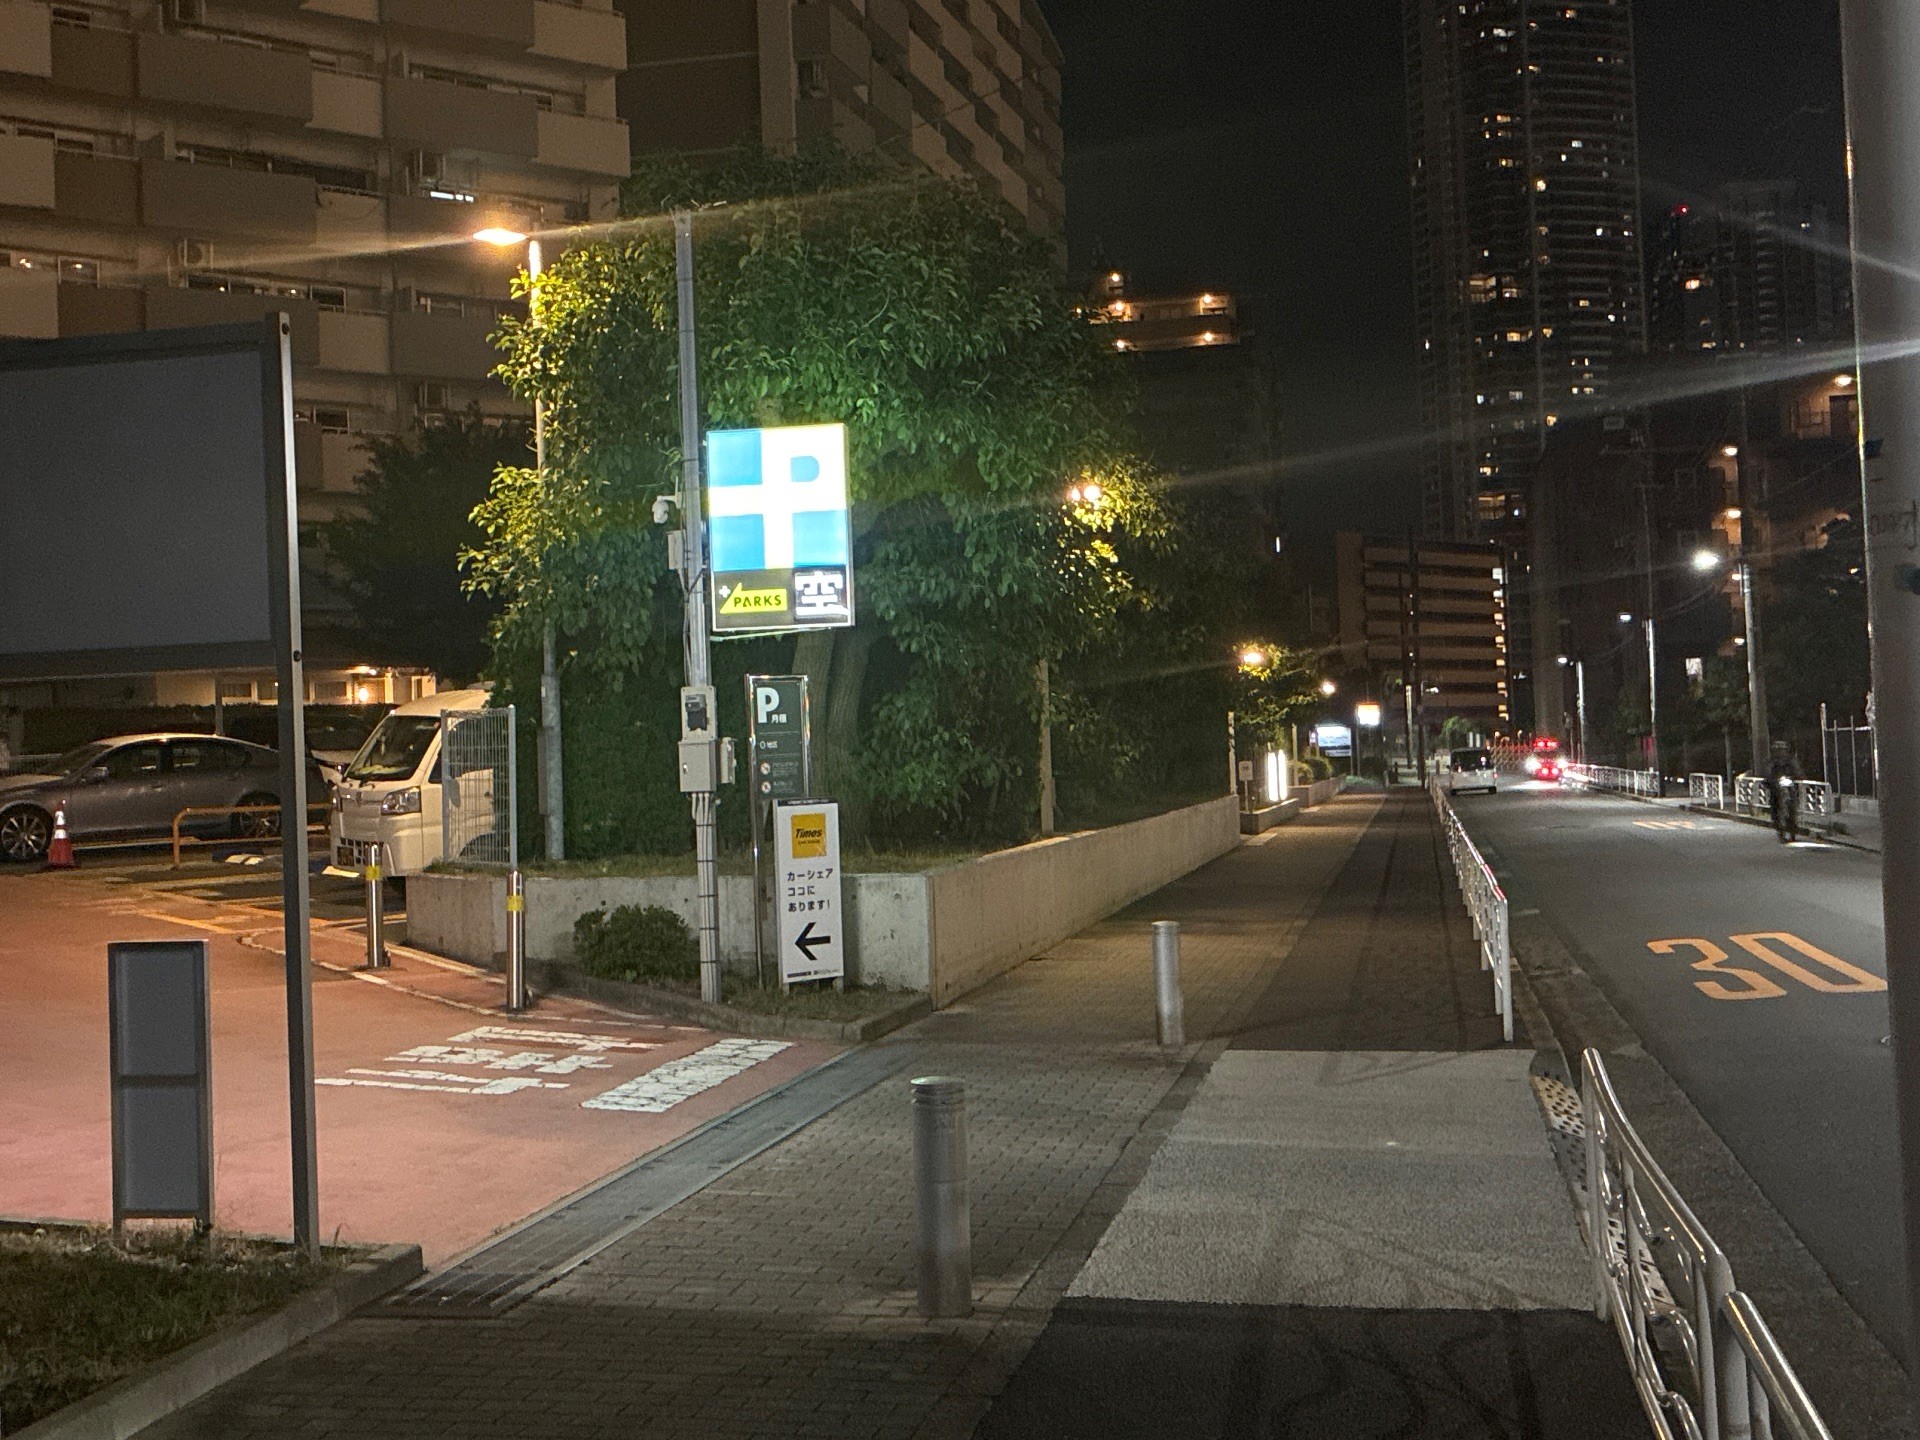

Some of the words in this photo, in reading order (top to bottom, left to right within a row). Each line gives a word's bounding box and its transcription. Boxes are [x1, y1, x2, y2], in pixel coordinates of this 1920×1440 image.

[794, 571, 849, 616] 空
[733, 594, 782, 608] PARKS
[756, 687, 780, 723] P
[795, 828, 823, 839] Times
[787, 868, 834, 882] カーシェア
[787, 885, 816, 897] ココに
[787, 899, 831, 913] あります!
[1647, 931, 1888, 1000] 30
